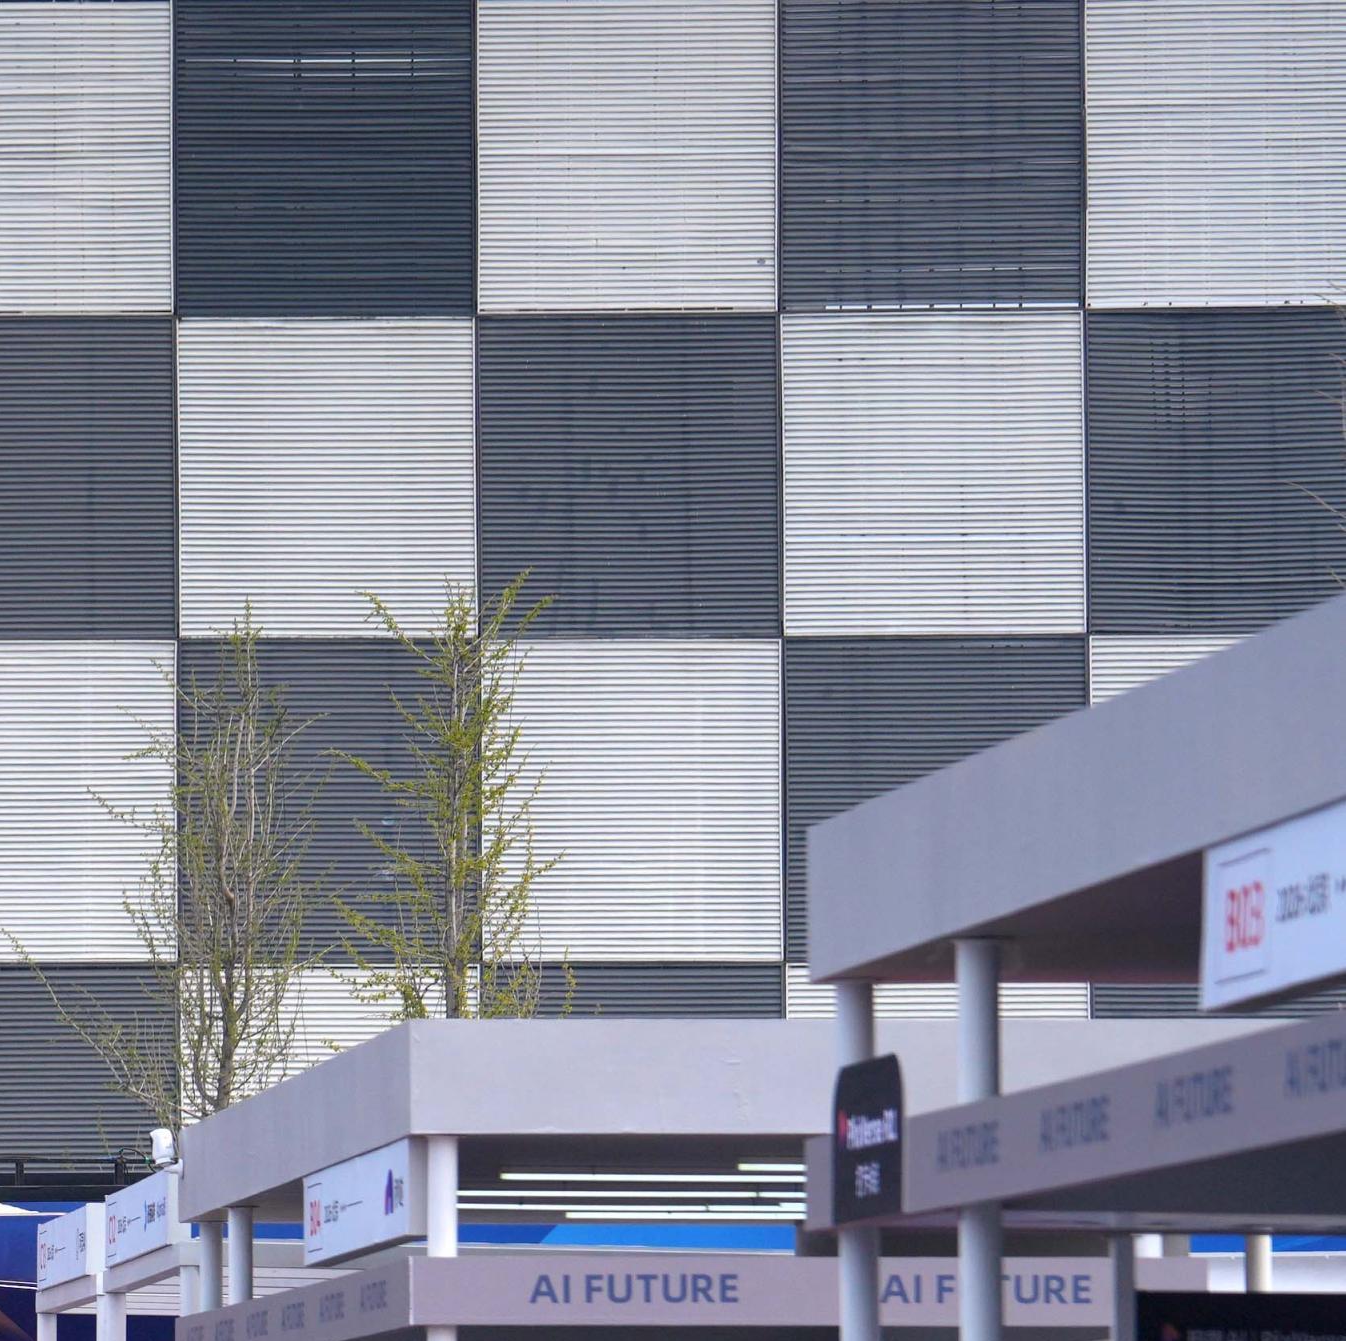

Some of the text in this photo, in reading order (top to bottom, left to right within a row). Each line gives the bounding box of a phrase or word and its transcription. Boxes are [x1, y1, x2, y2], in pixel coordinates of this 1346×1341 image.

[530, 1273, 739, 1304] AI FUTURE
[880, 1274, 921, 1303] AI
